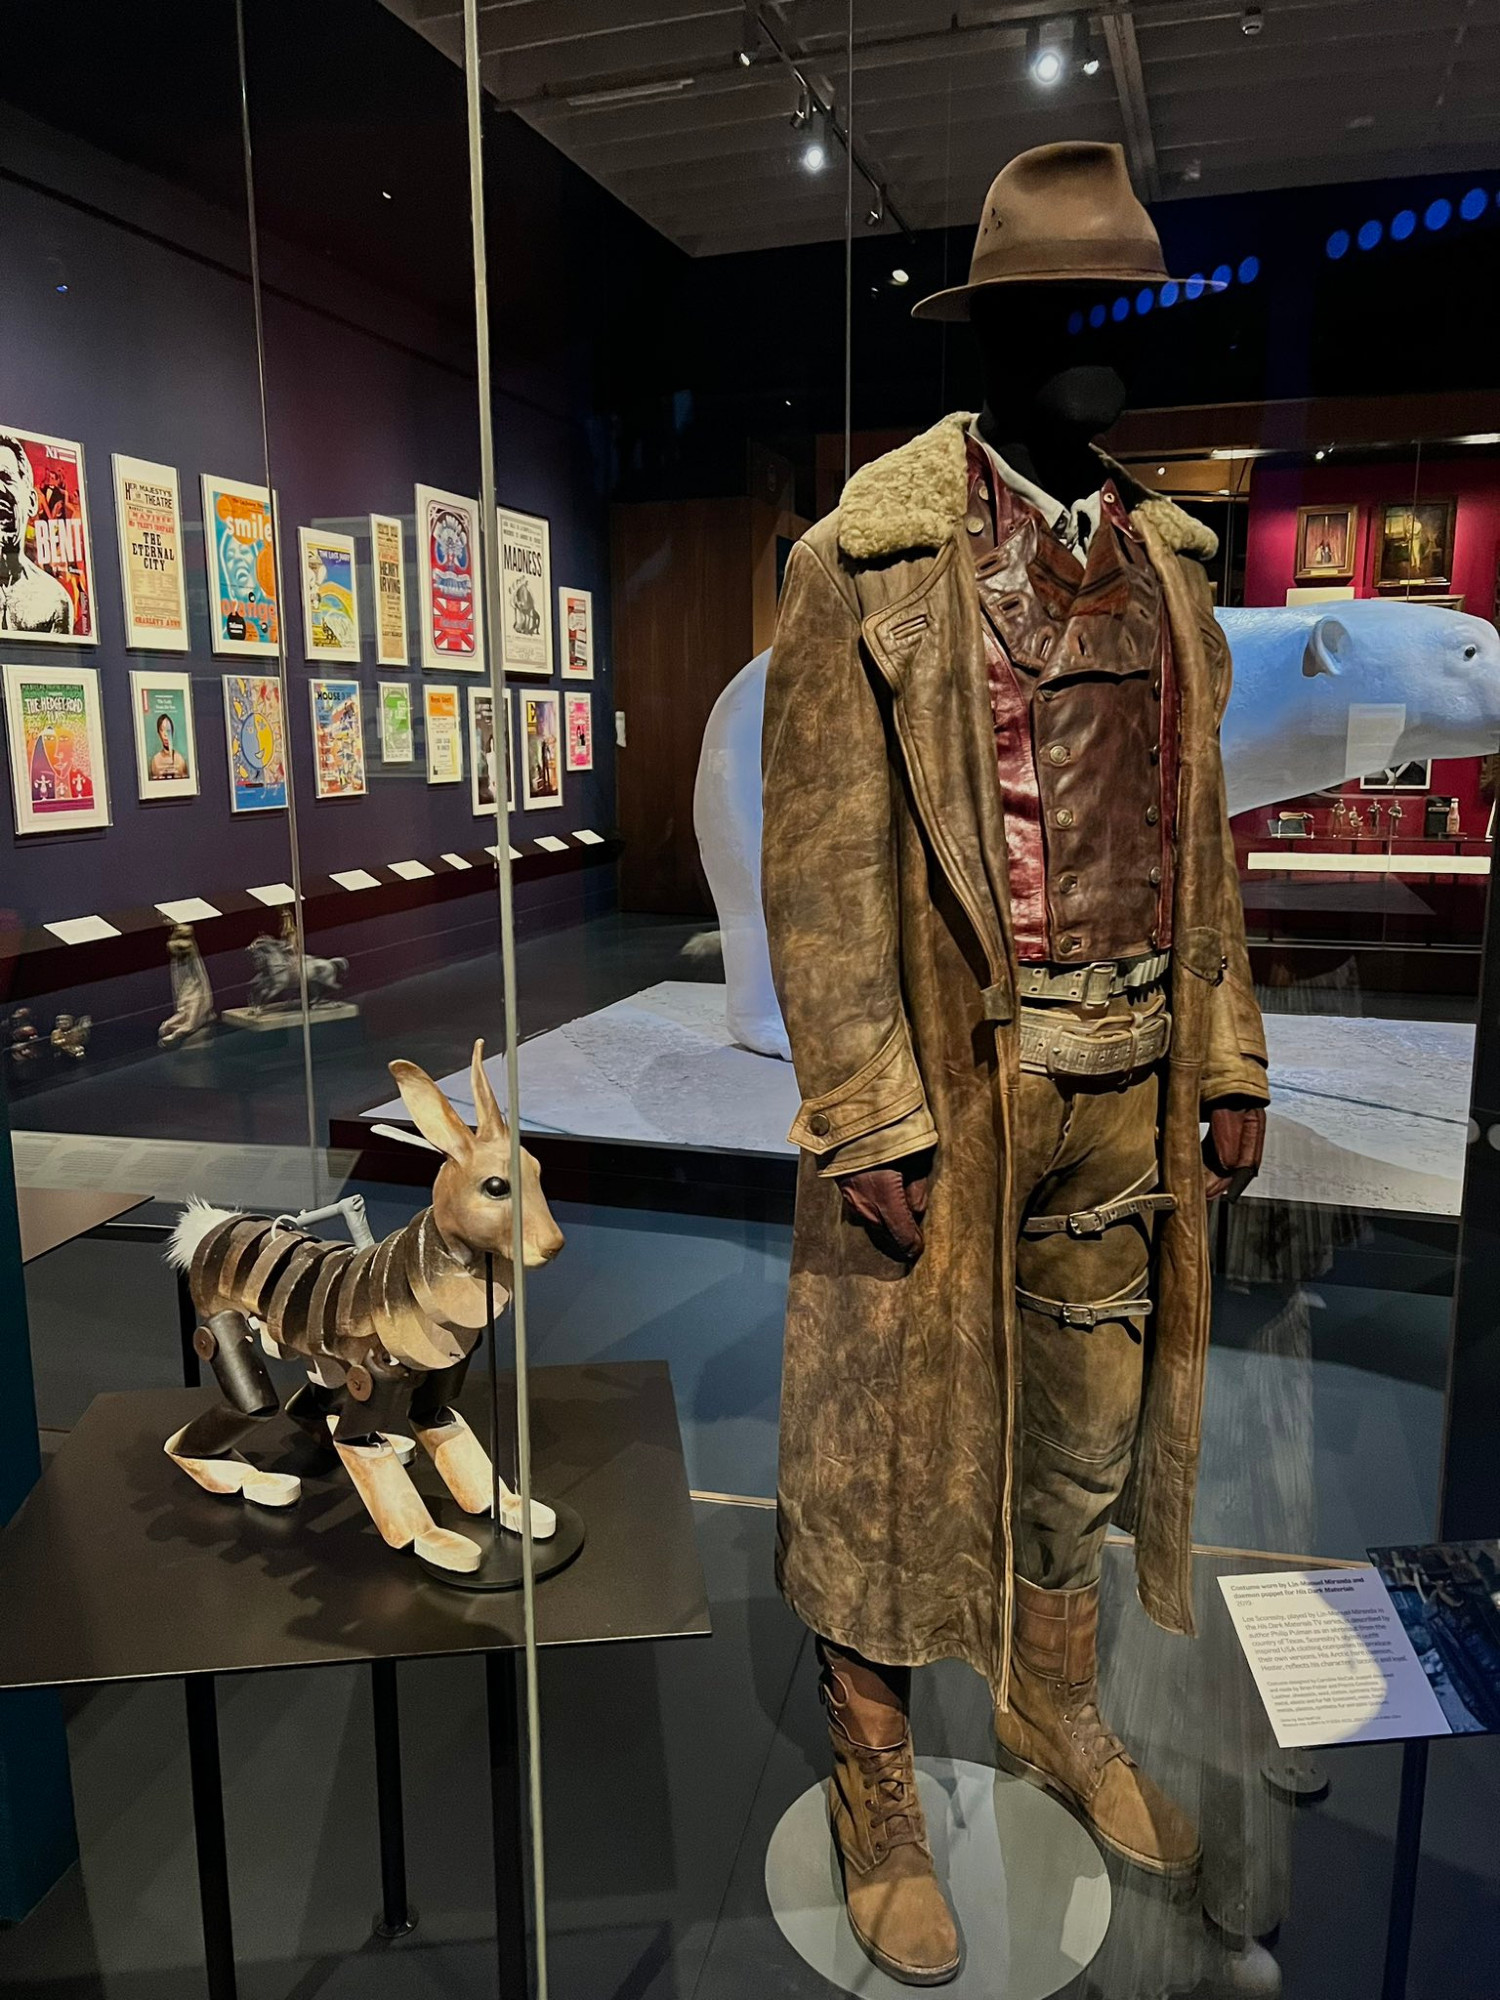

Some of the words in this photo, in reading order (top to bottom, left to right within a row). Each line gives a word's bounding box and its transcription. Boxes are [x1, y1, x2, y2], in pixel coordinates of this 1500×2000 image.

[144, 493, 173, 509] THEATRE
[226, 513, 272, 542] smile
[34, 518, 83, 564] BENT
[143, 532, 161, 546] THE
[131, 543, 175, 560] ETERNAL
[143, 558, 165, 571] CITY
[504, 544, 541, 577] MADNESS
[380, 561, 399, 578] HENRY
[380, 576, 401, 594] IRVING
[221, 598, 276, 622] orange
[317, 691, 341, 701] HOUSE
[1283, 1619, 1312, 1627] Materials
[1286, 1612, 1307, 1620] played
